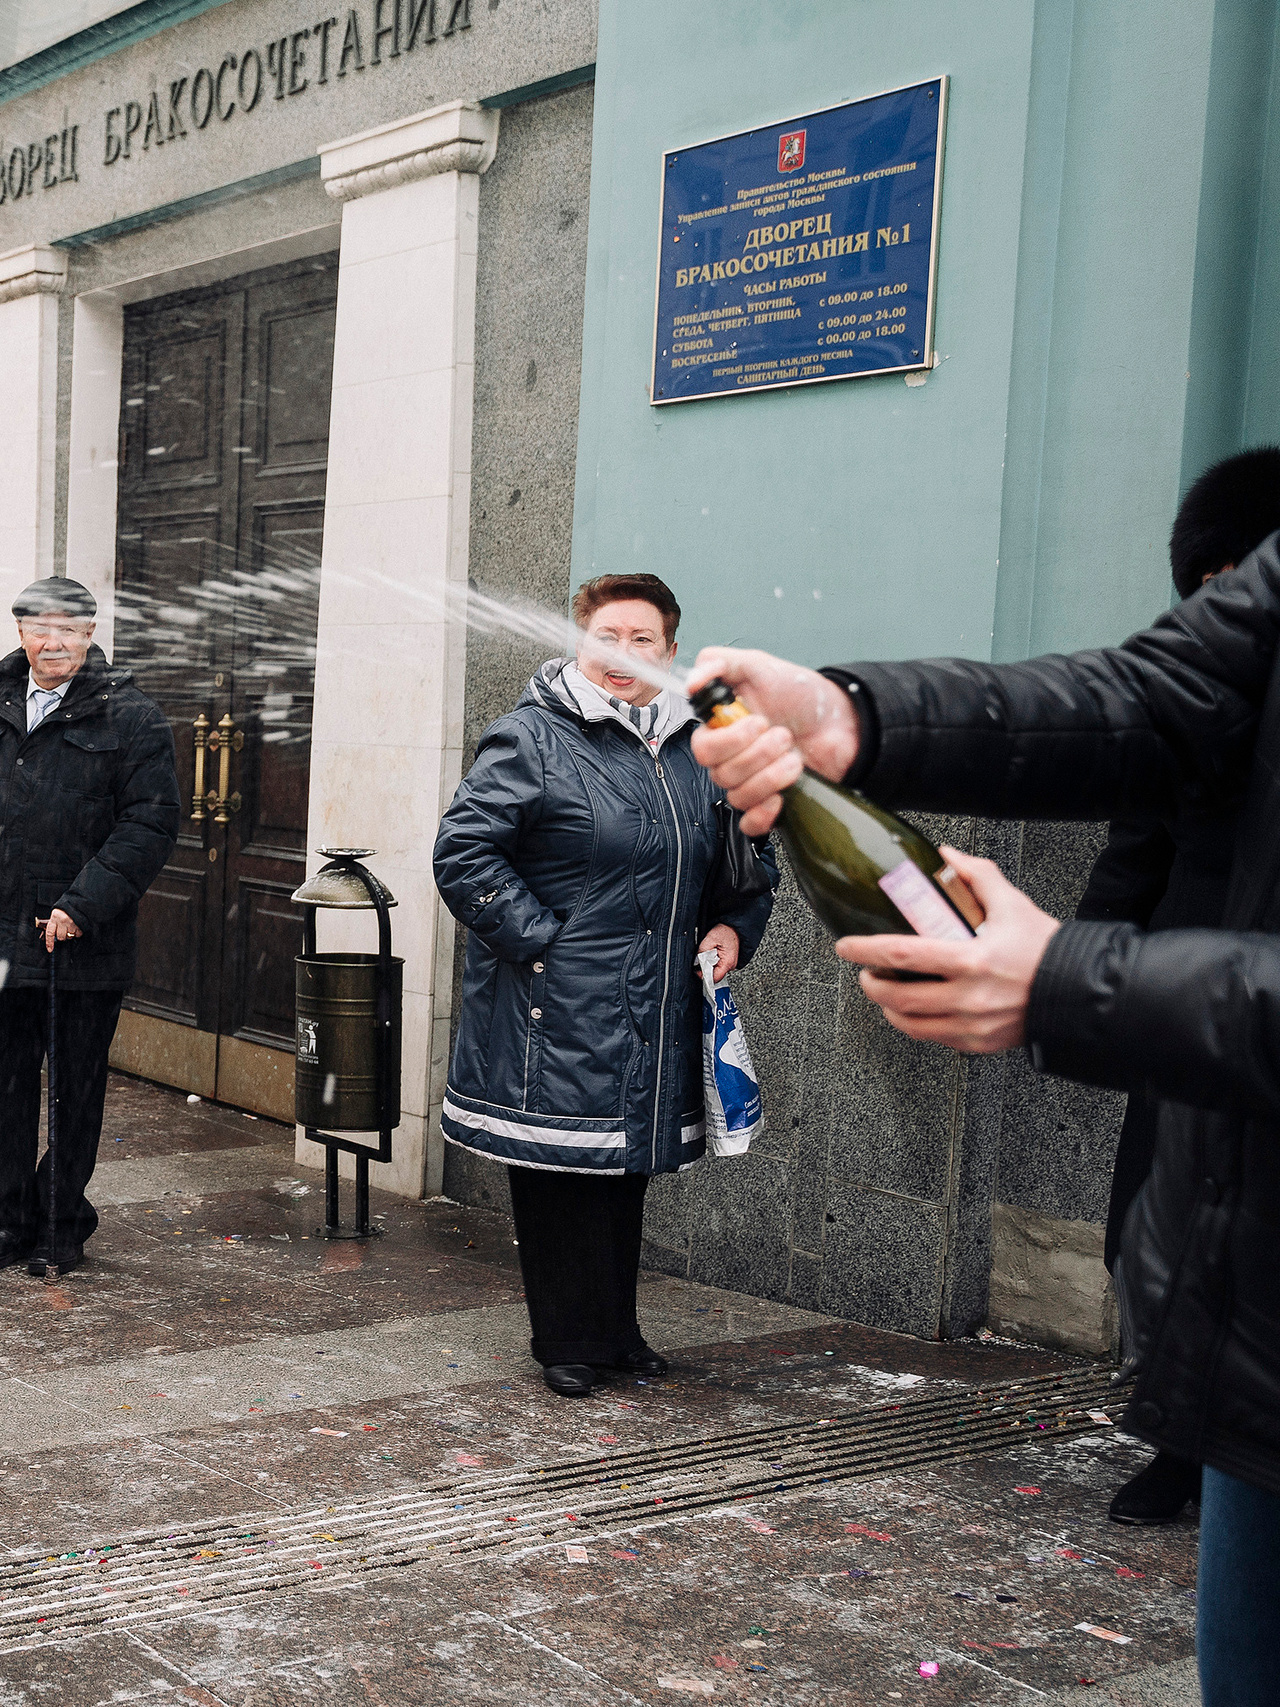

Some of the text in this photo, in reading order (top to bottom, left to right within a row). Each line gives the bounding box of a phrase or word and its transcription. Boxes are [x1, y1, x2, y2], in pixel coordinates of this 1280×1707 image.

[677, 162, 917, 224] Управление записи актов гражданского состояния
[737, 167, 847, 200] Правительство Москвы
[753, 194, 826, 217] города Москвы
[743, 213, 832, 253] ДВОРЕЦ
[675, 231, 870, 288] БРАКОСОЧЕТАНИЯ
[743, 271, 827, 297] ЧАСЫ РАБОТЫ
[673, 283, 908, 327] ПОНЕДЕЛЬНИК, ВТОРНИК, с 09.00 до 18.00
[672, 308, 802, 339] СРЕДА, ЧЕТВЕРГ, ПЯТНИЦА
[672, 306, 907, 354] СУББОТА с 09.00 до 24.00
[671, 323, 906, 368] ВОСКРЕСЕНЬЕ с 00.00 до 18.00
[712, 349, 853, 377] ПЕРВЫЙ ВТОРНИК КАЖДОГО МЕСЯЦА
[737, 364, 826, 385] САНИТАРНЫЙ ДЕНЬ
